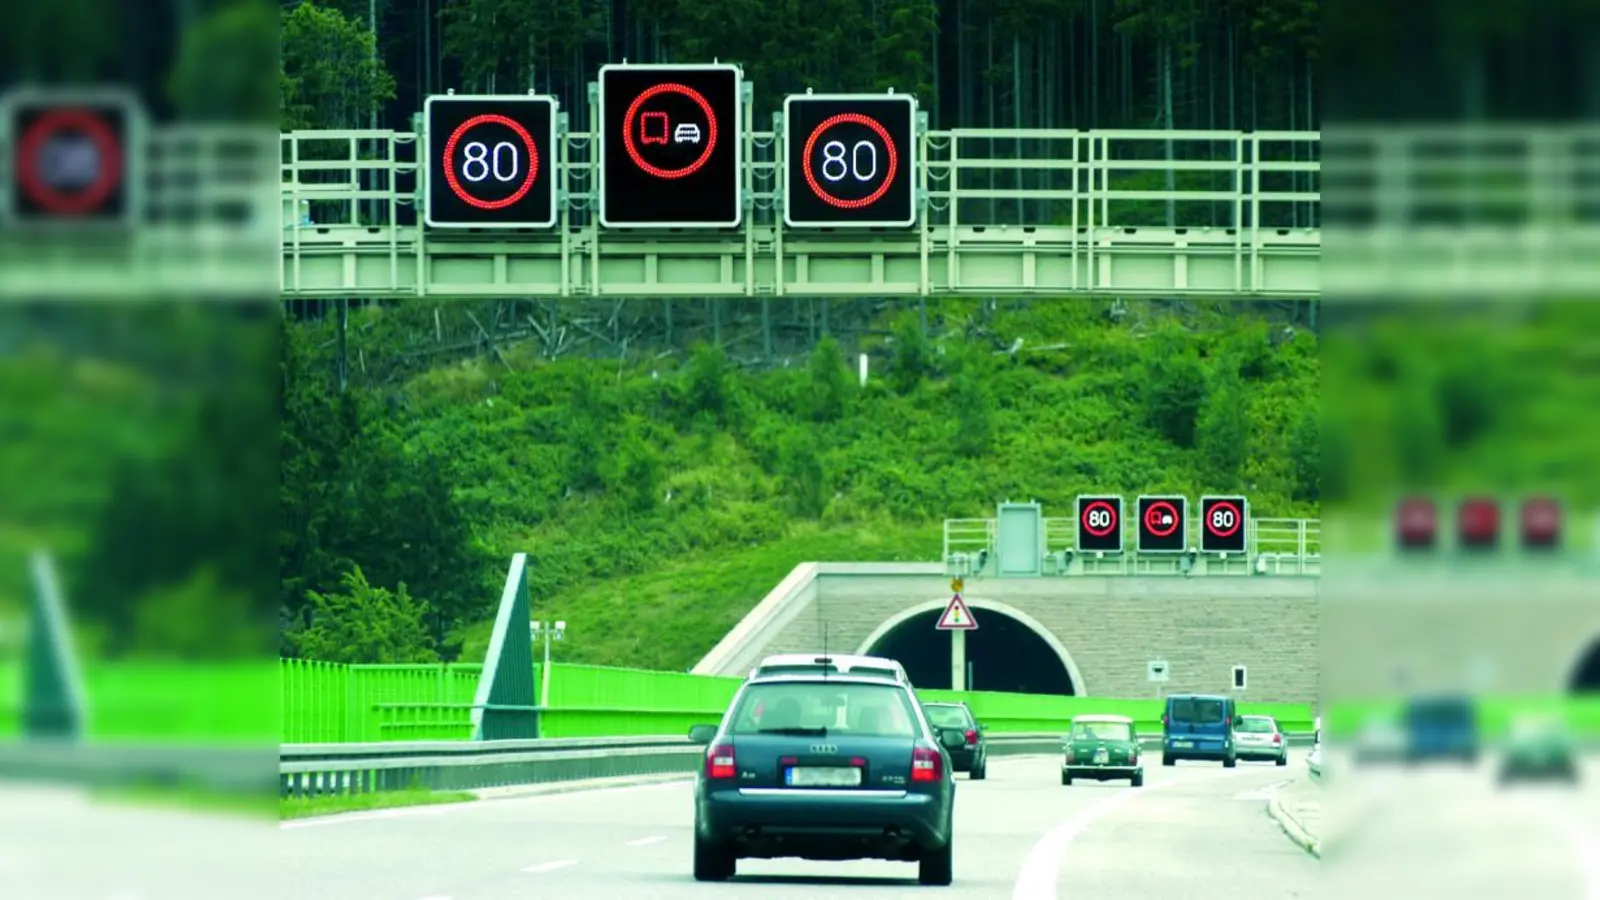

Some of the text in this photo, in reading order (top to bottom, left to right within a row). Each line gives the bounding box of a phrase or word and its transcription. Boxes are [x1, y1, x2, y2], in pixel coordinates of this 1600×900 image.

[463, 141, 518, 181] 80
[822, 140, 876, 181] 80
[1089, 510, 1110, 527] 80
[1212, 510, 1234, 527] 80
